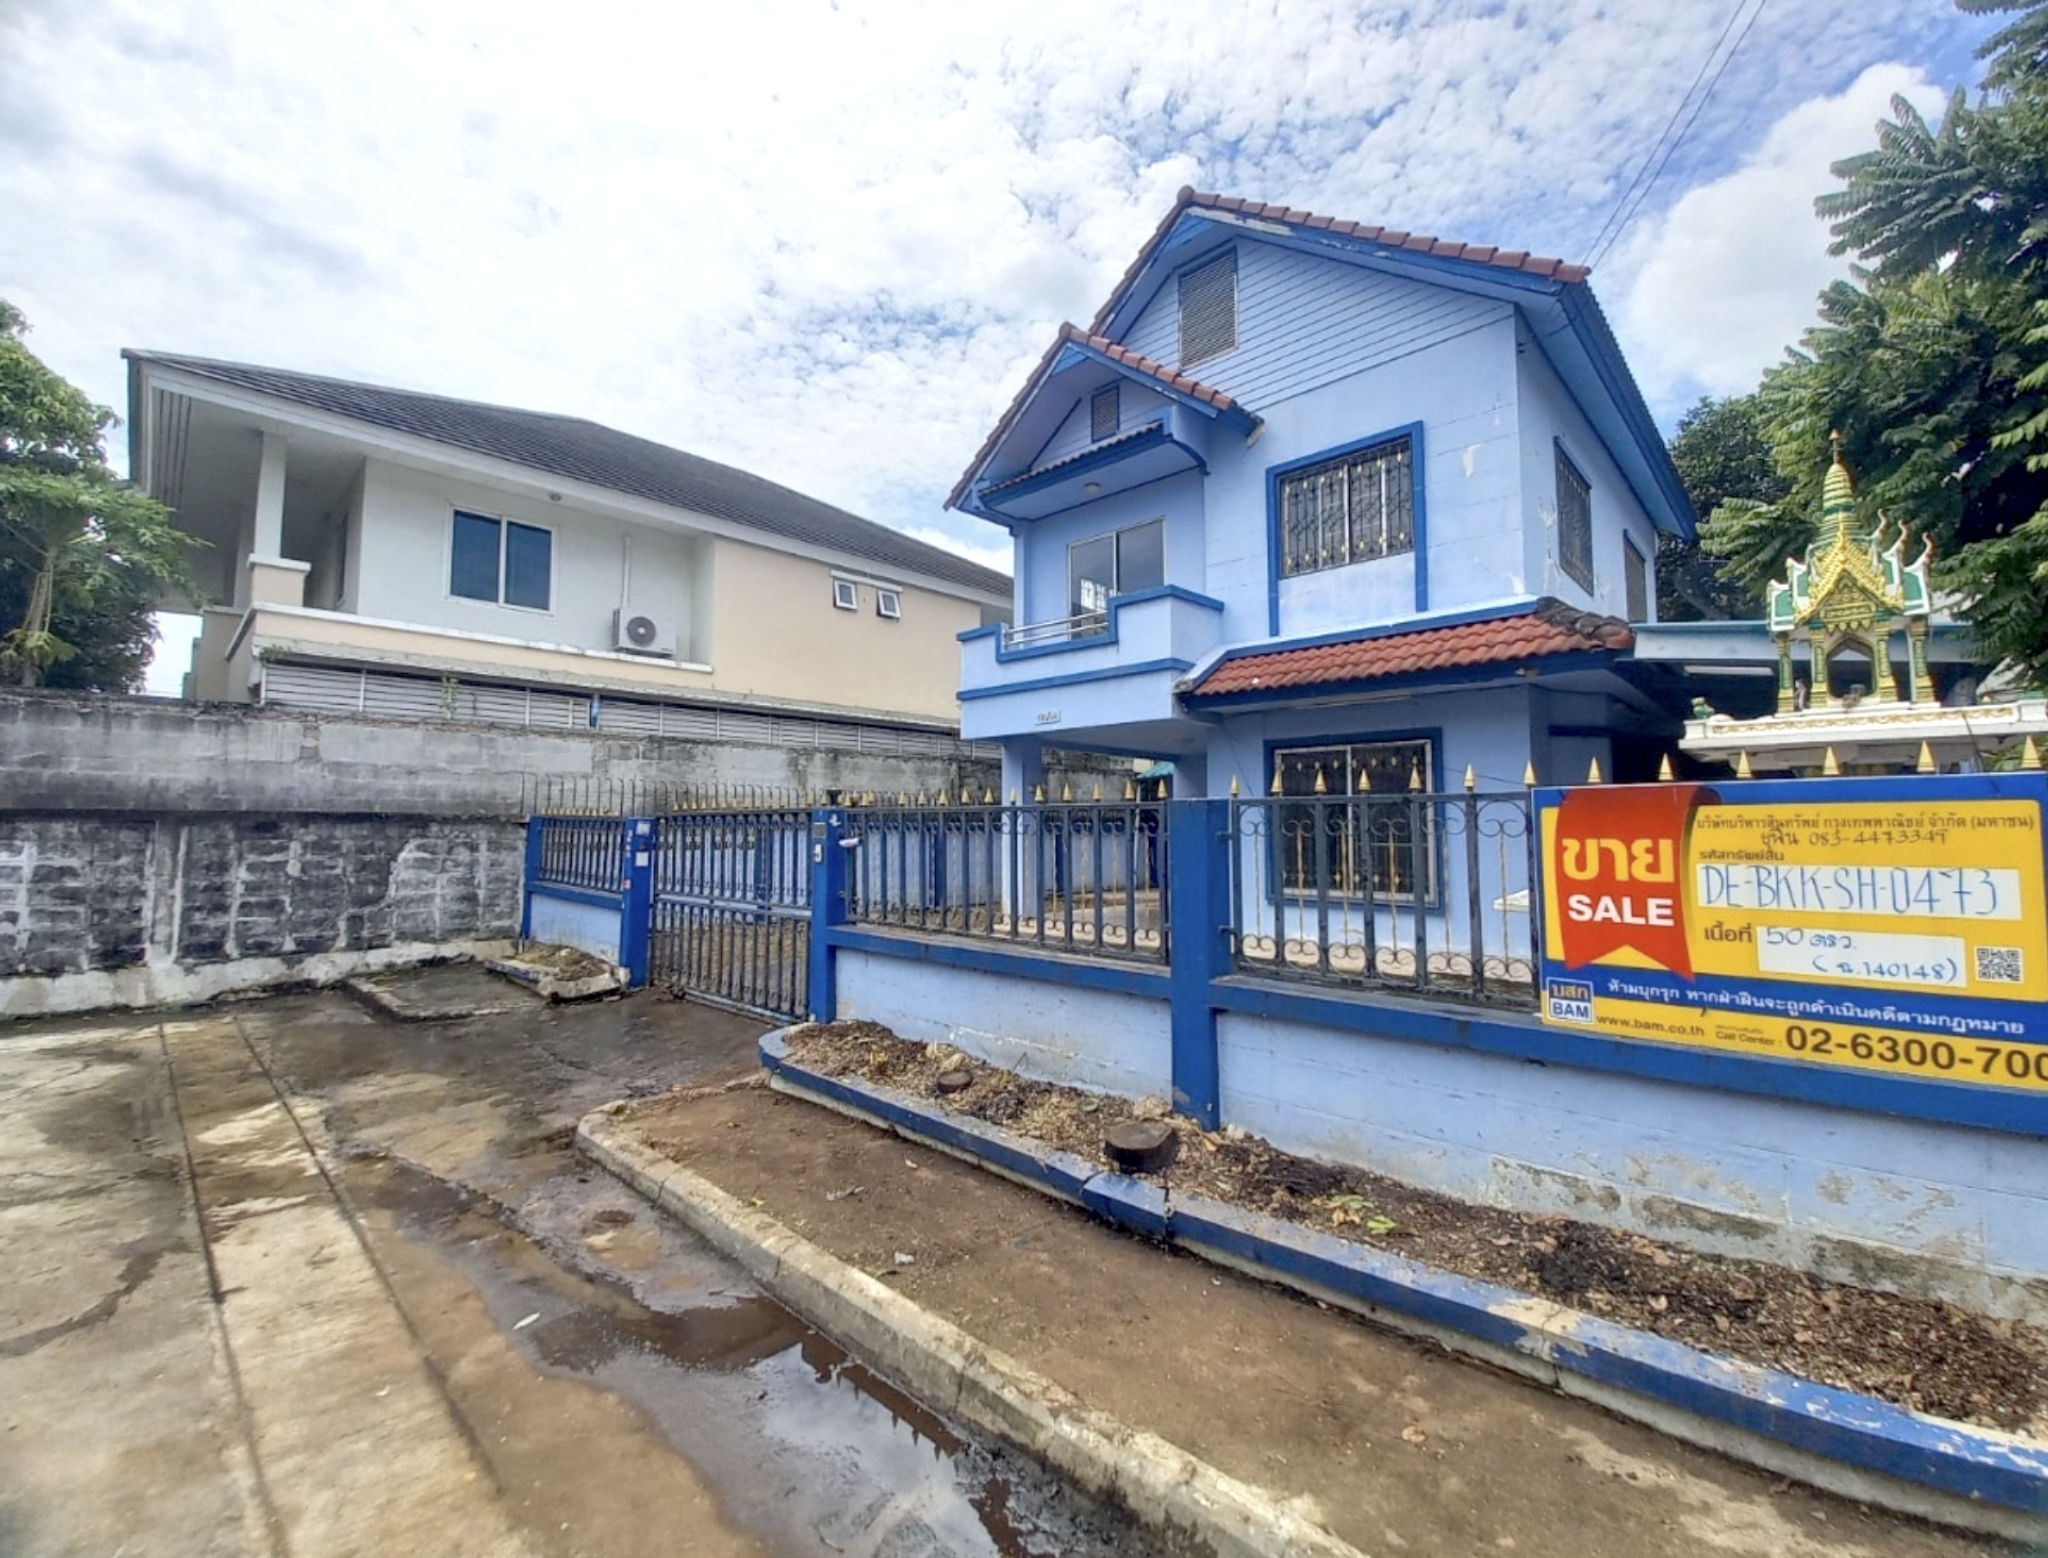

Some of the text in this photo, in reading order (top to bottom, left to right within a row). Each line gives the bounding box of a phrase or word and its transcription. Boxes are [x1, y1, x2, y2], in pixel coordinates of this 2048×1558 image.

[1823, 811, 1924, 832] กรุงเทพพาณิชย์
[1928, 811, 1967, 829] จำกัด
[1970, 814, 2035, 831] (มหาชน)
[1562, 837, 1675, 883] ขาย
[1698, 847, 1785, 862] รหัสทรัพย์สิน
[1701, 863, 1998, 915] DE-BKK-SH-0473
[1567, 893, 1675, 927] SALE
[1704, 919, 1753, 943] เนื้อที่
[1766, 925, 1804, 946] 50
[1551, 982, 1589, 1000] บสก
[1607, 977, 1681, 1003] ห้ามบุกรุก
[1552, 1000, 1590, 1019] BAM
[1597, 1014, 1705, 1037] www.bam.co.th
[1715, 1030, 1736, 1042] Call
[1739, 1034, 1776, 1047] Center
